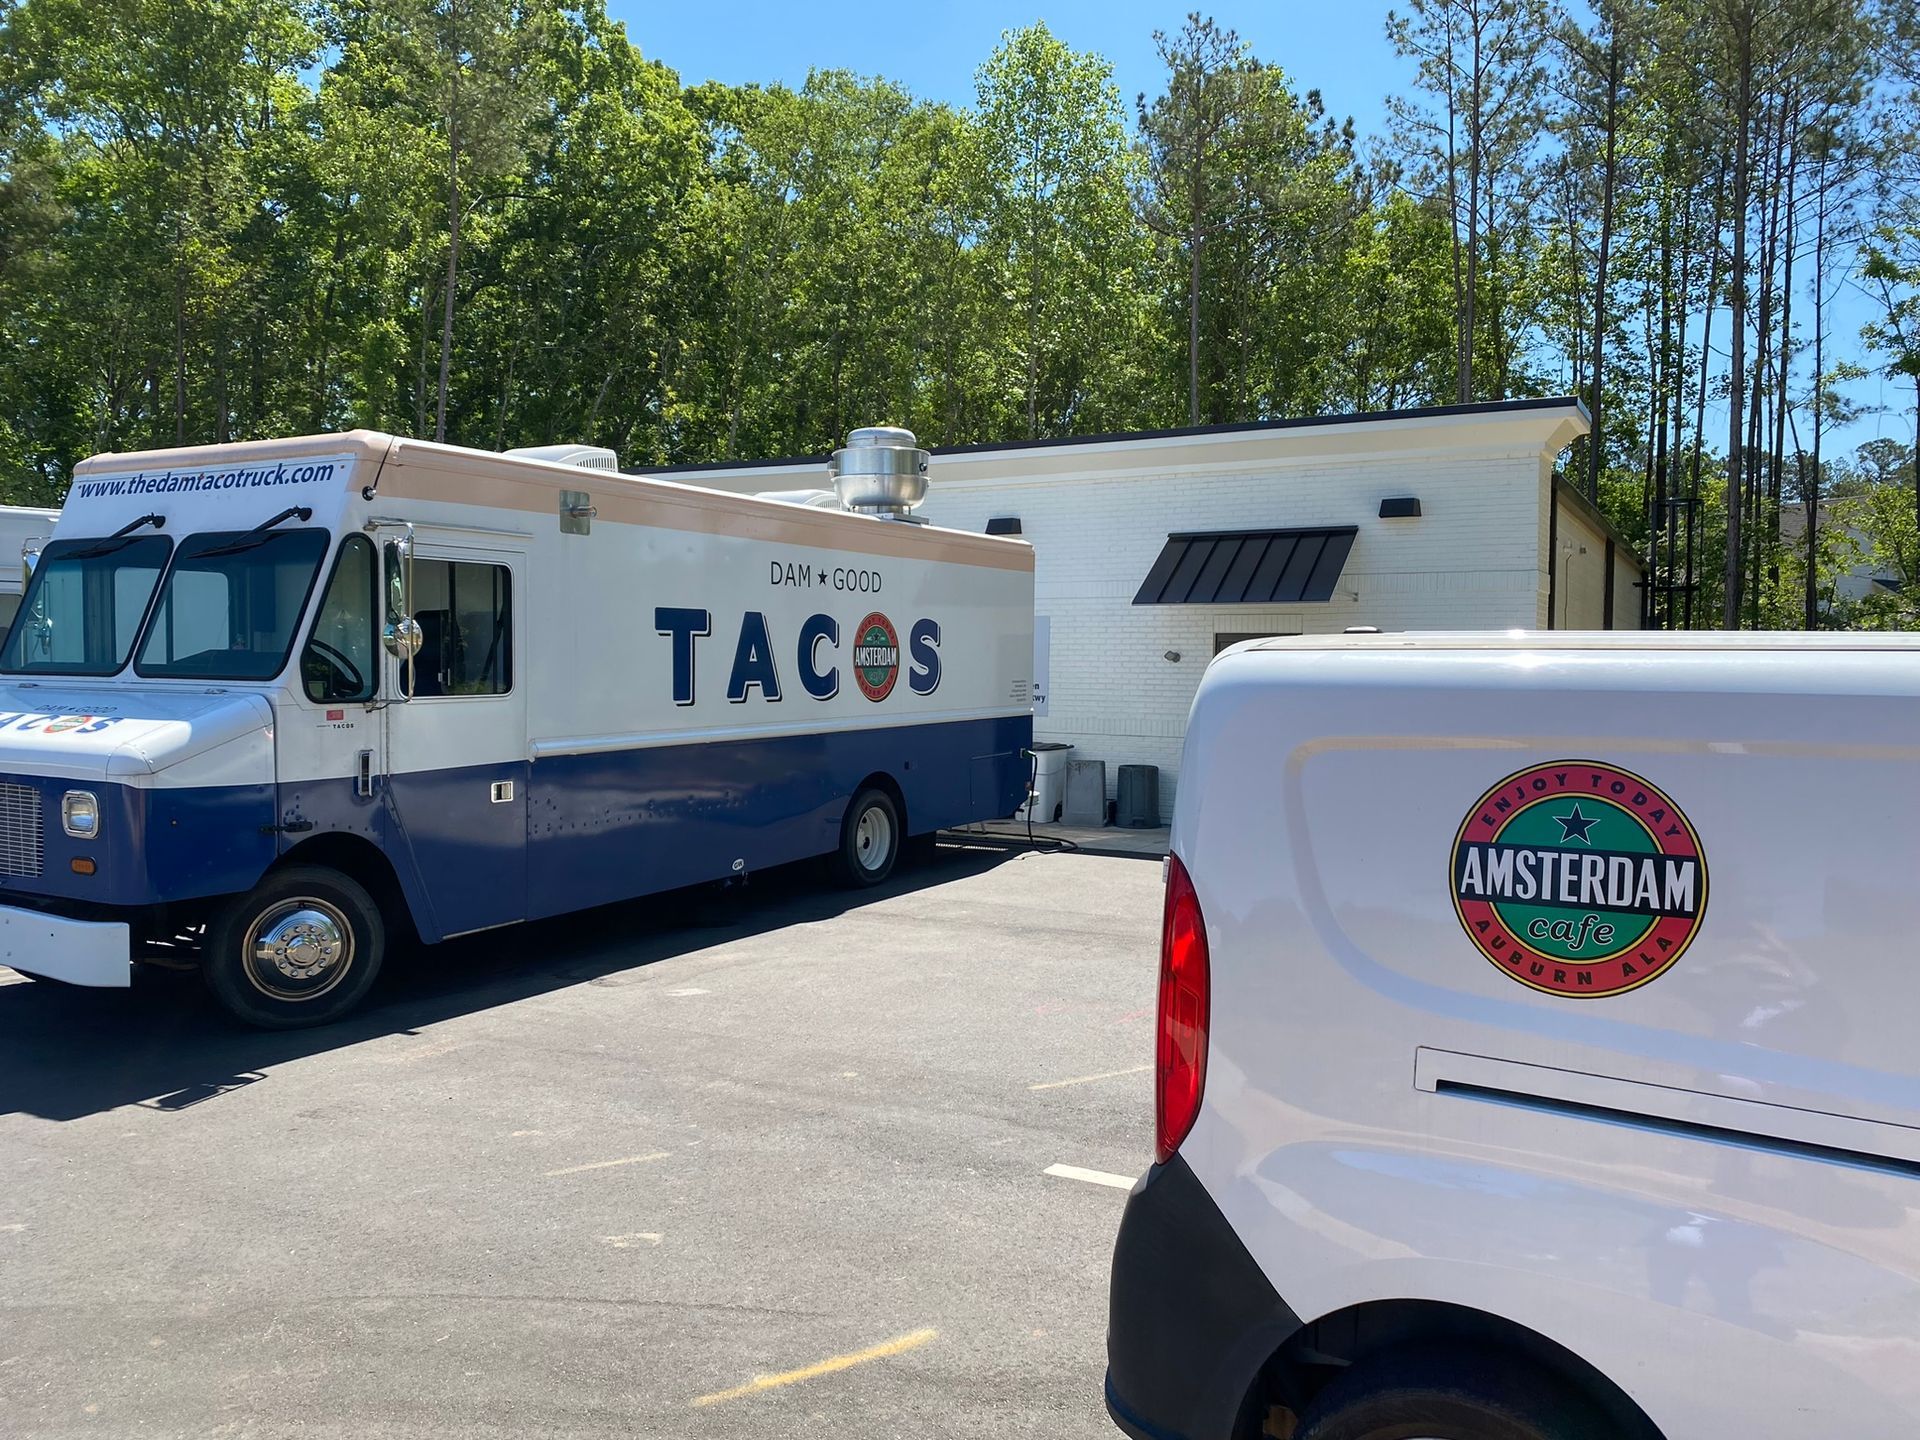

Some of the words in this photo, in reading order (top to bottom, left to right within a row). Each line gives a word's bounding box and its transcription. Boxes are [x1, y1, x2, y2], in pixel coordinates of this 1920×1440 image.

[79, 463, 334, 498] www.thedamtacotruck.com
[771, 561, 811, 588] DAM
[832, 567, 882, 593] GOOD
[654, 606, 942, 706] TACOS
[855, 646, 897, 666] AMSTERDAM
[1481, 773, 1568, 827] ENJOY
[1591, 774, 1681, 838] TODAY
[1460, 846, 1695, 913] AMSTERDAM
[1475, 919, 1592, 985] AUBURN
[1621, 935, 1673, 977] ALA
[1527, 914, 1615, 951] cafe
